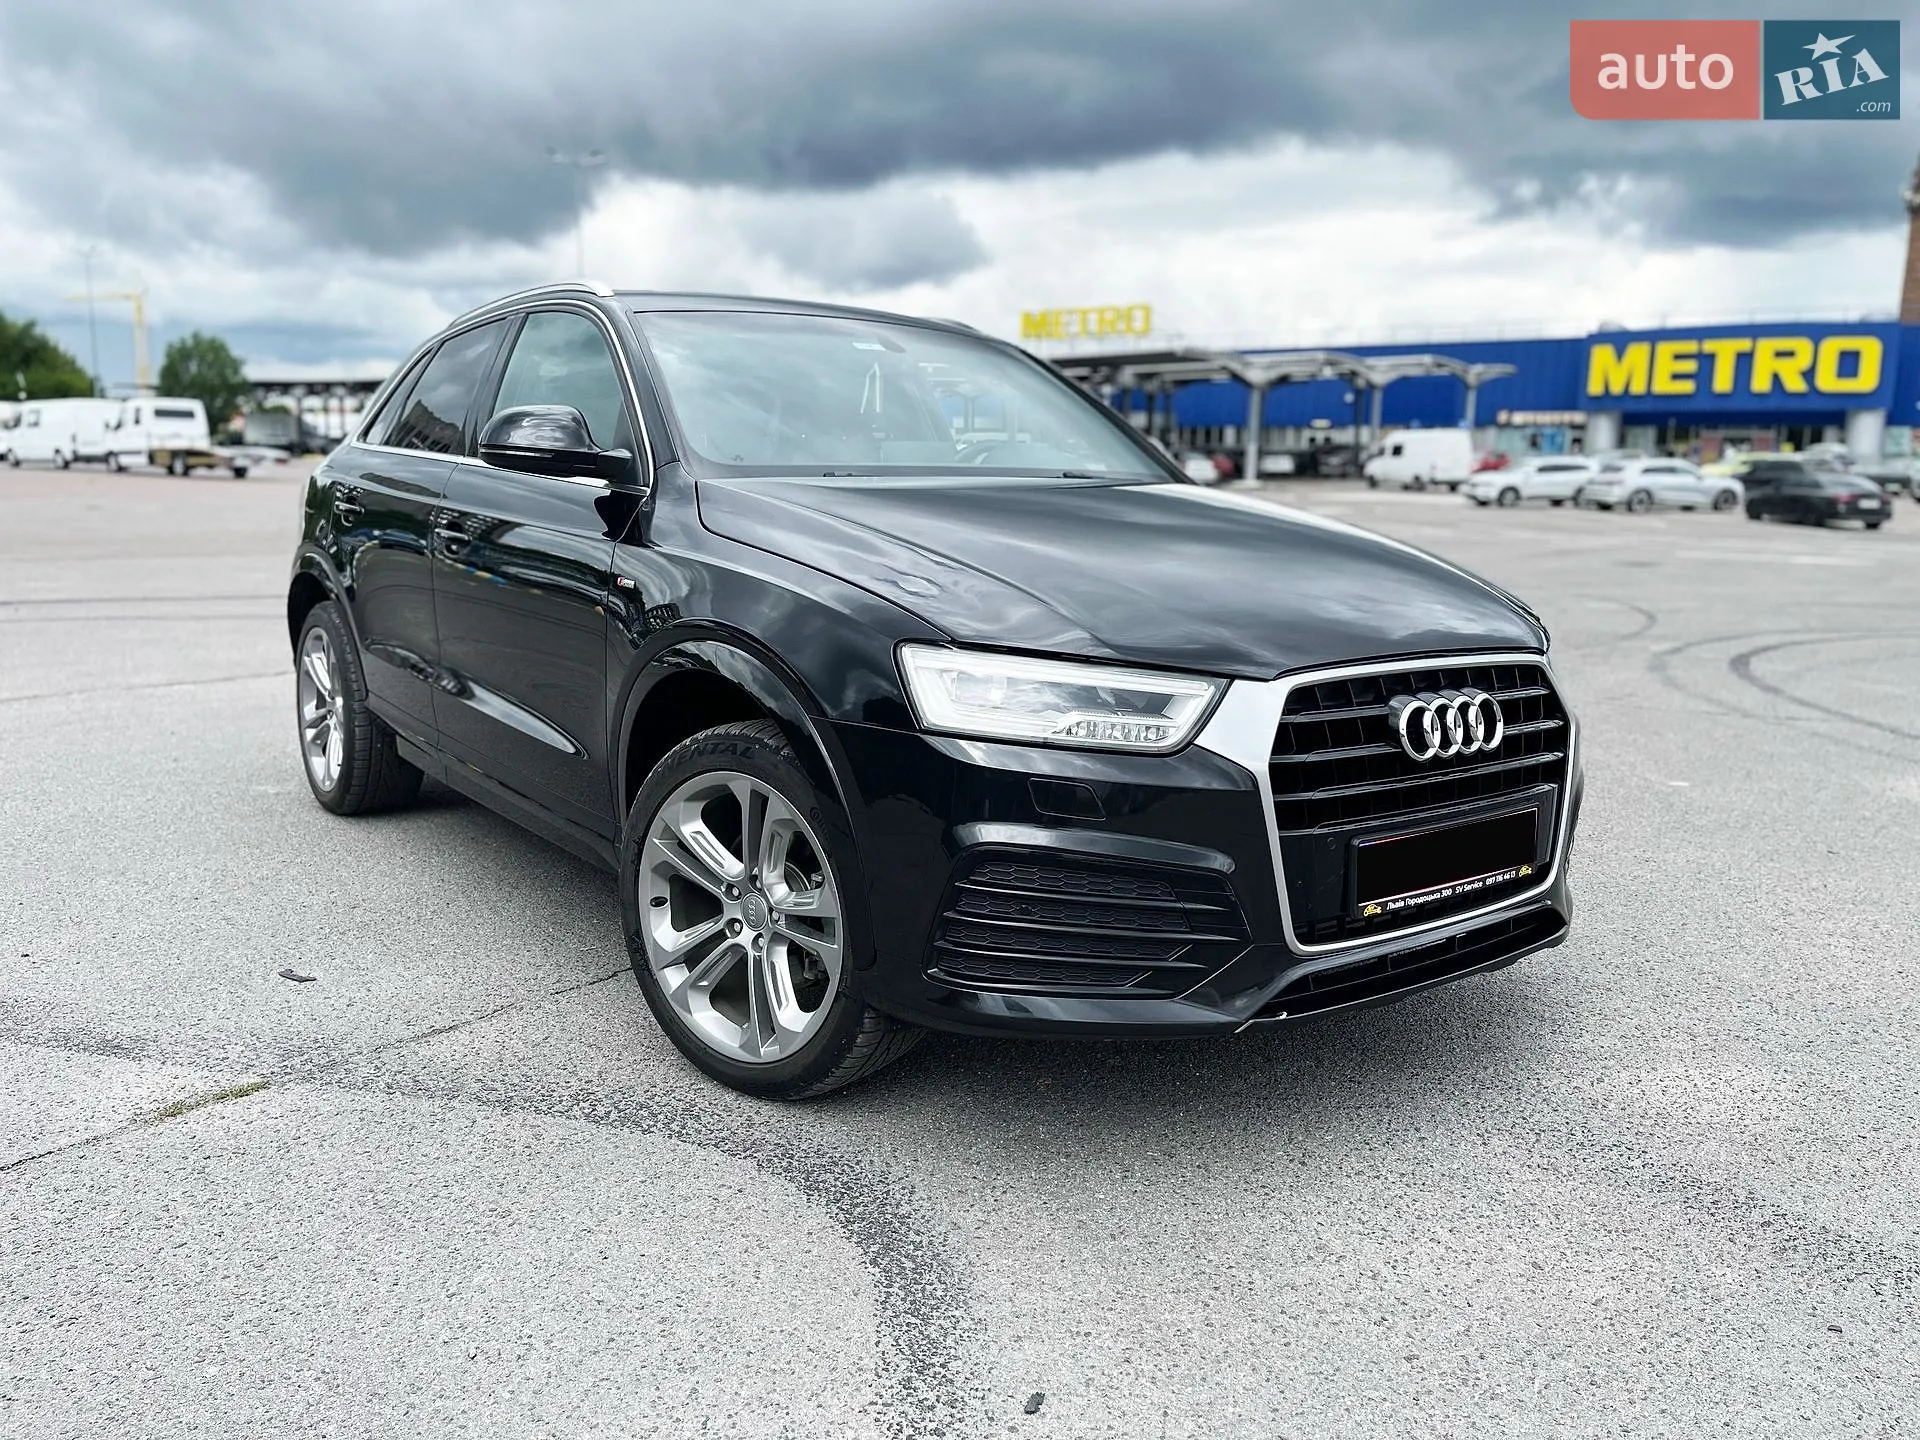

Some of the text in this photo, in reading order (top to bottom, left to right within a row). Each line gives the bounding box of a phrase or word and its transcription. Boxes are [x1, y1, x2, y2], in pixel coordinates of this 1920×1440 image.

[1021, 304, 1152, 339] METRO
[1586, 335, 1884, 397] METRO
[1440, 888, 1453, 898] 300
[1463, 880, 1484, 892] Service
